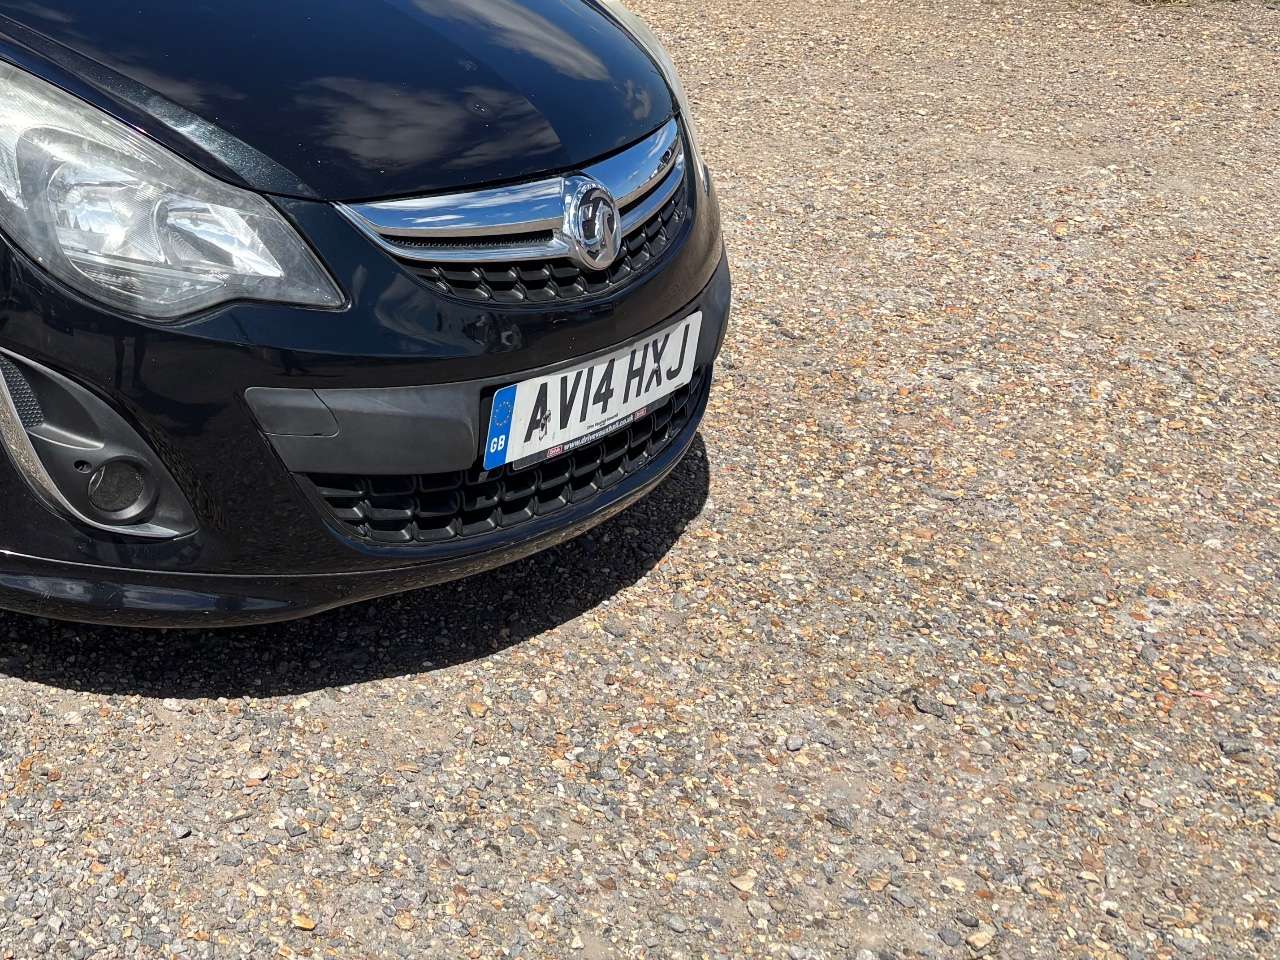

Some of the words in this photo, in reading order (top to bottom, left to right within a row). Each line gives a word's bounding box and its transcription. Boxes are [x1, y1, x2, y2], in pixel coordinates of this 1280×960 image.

[523, 358, 616, 444] AV14
[623, 324, 691, 404] HXJ
[490, 435, 506, 453] GB
